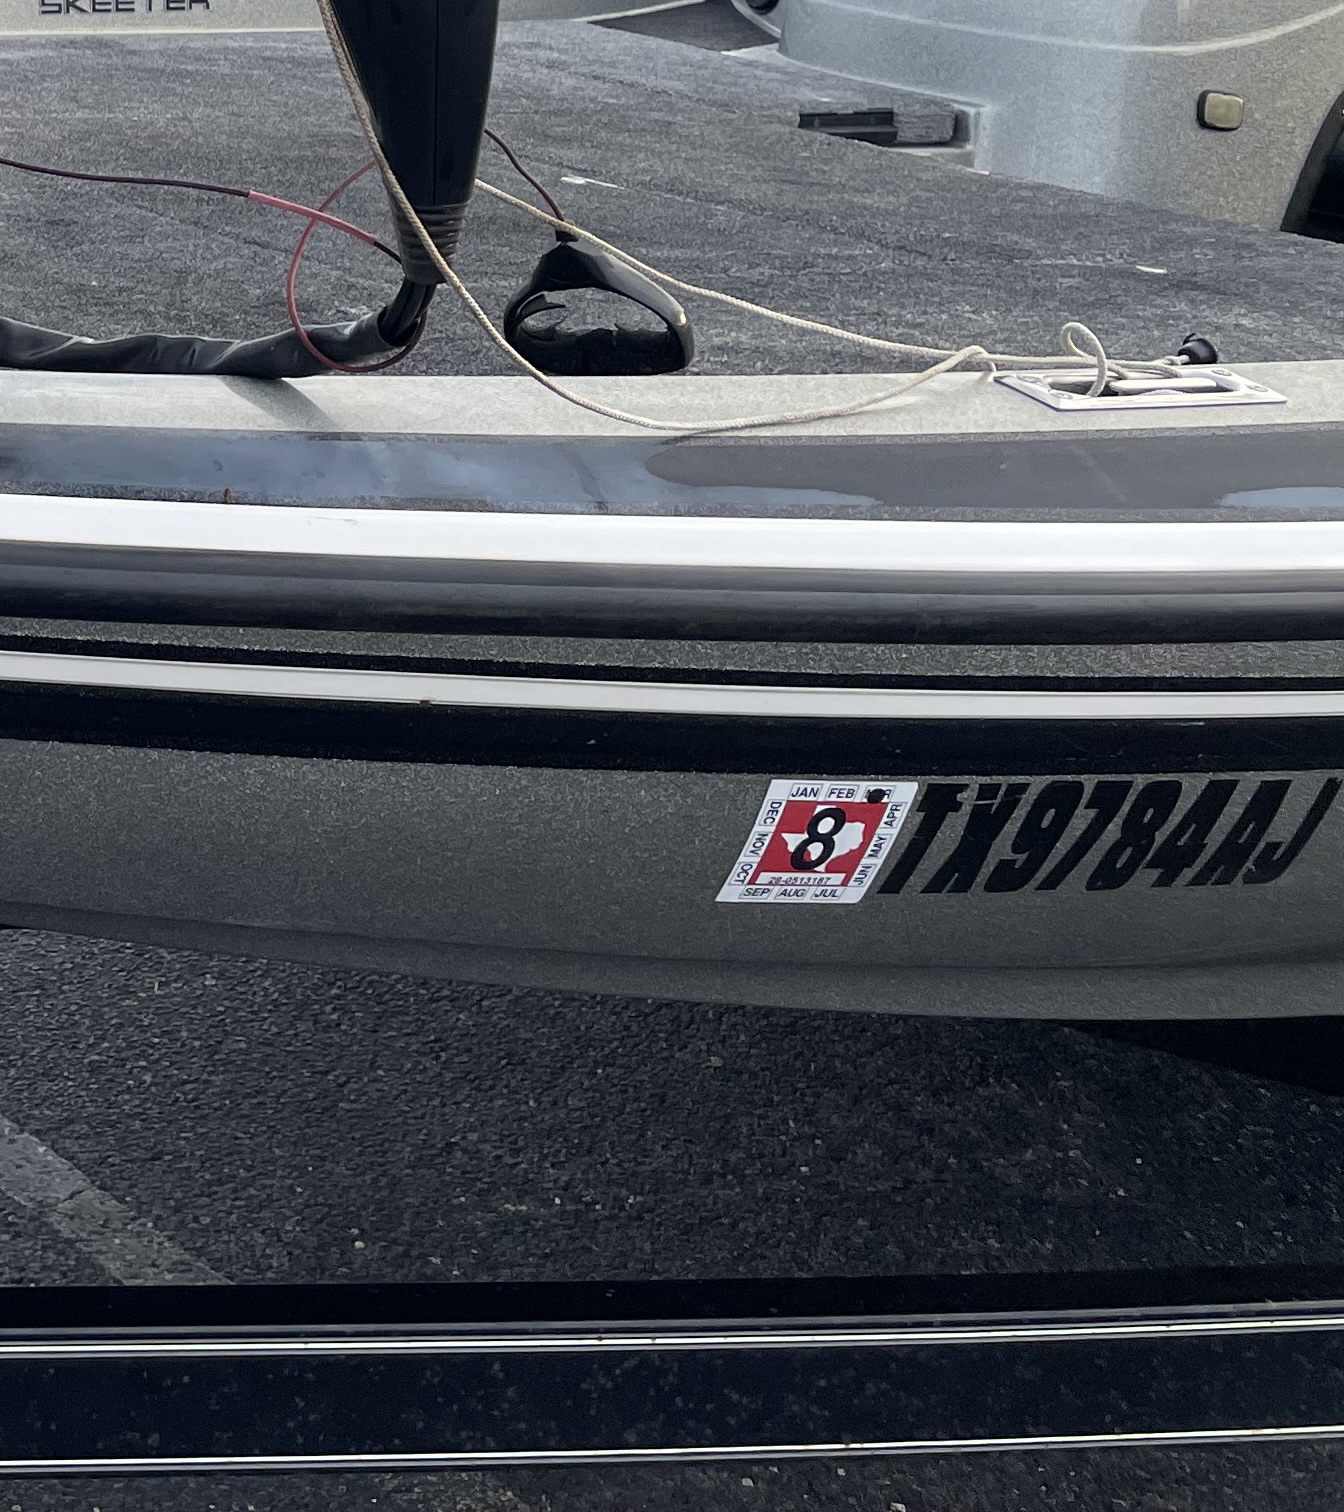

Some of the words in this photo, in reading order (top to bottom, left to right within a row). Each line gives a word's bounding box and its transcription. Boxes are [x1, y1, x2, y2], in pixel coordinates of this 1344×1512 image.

[790, 788, 819, 798] JAN
[827, 788, 856, 799] FEB
[764, 801, 782, 824] DEC
[884, 803, 903, 828] APR
[749, 833, 769, 856] NOV
[790, 807, 847, 871] 8
[867, 836, 888, 859] MAY
[733, 863, 753, 884] OCT
[853, 864, 873, 885] JUN
[742, 888, 771, 897] SEP
[778, 888, 807, 898] AUG
[814, 888, 840, 898] JUL
